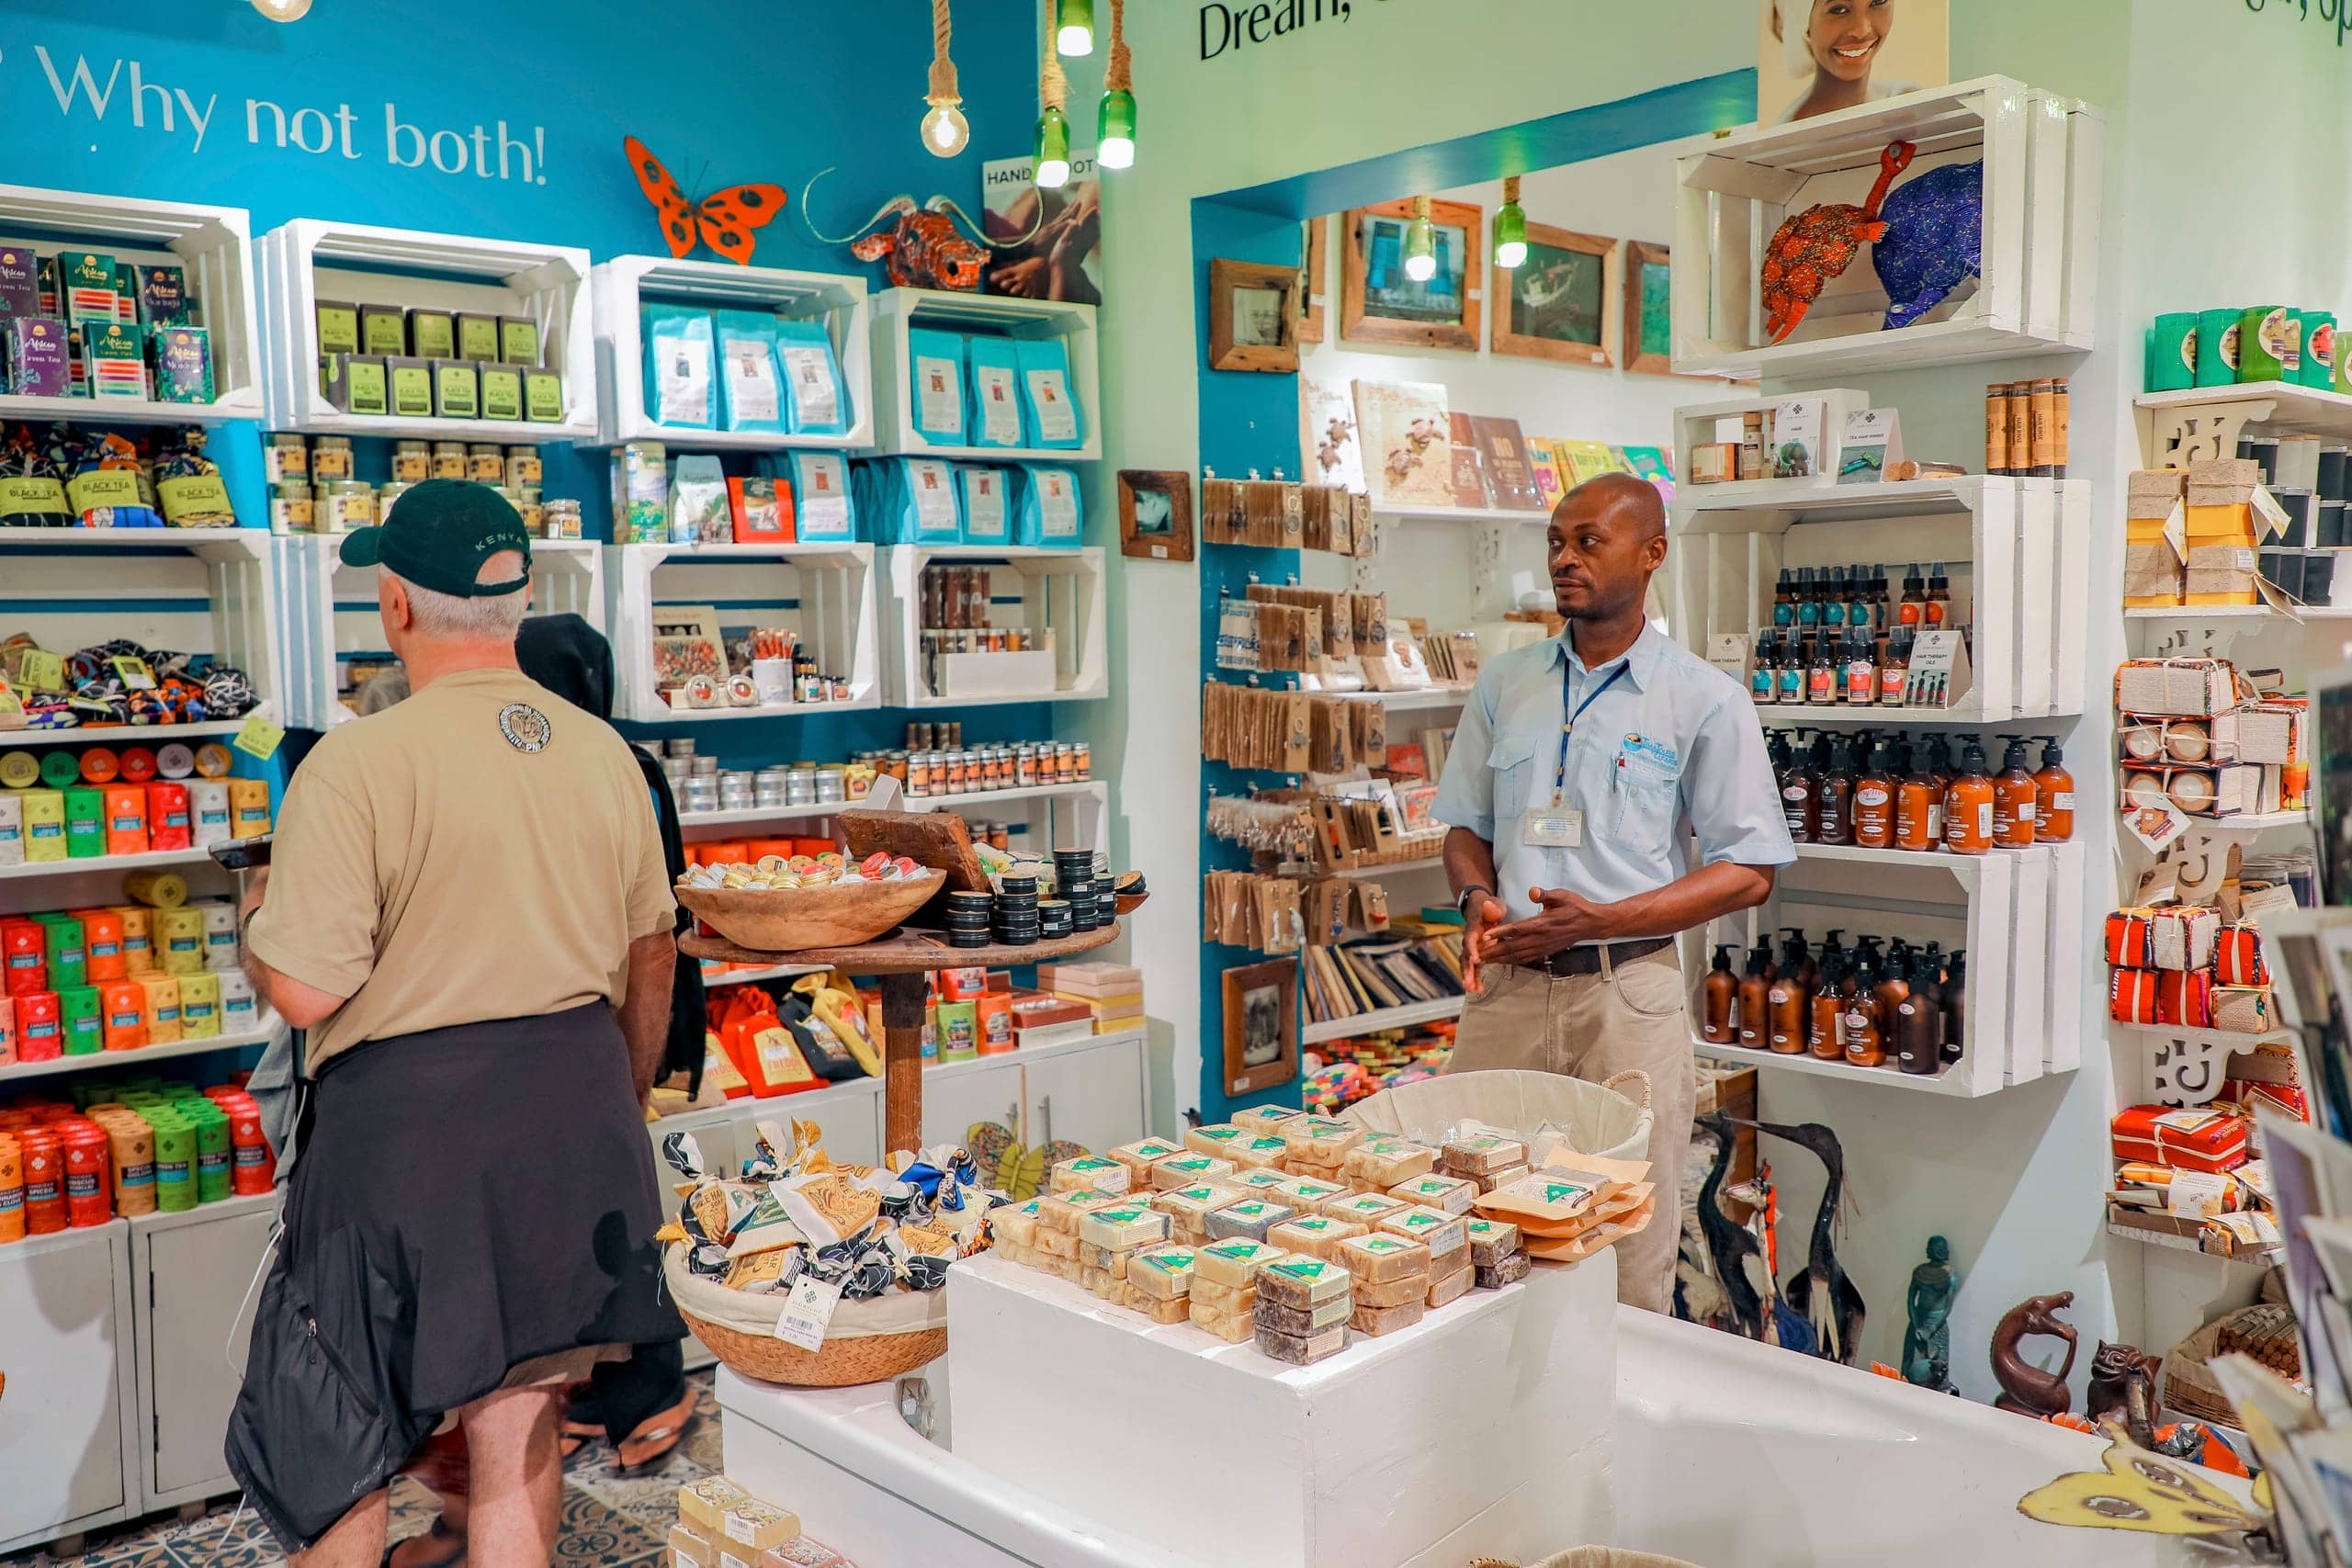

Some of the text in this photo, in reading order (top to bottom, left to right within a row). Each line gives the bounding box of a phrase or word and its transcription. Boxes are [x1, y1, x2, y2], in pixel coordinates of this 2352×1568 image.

[34, 45, 548, 186] Why not both!
[988, 166, 1033, 186] HAND
[9, 489, 59, 498] BLACK TEA
[83, 481, 130, 492] BLACK TEA
[176, 488, 221, 499] BLACK TEA
[474, 533, 525, 551] KENYA
